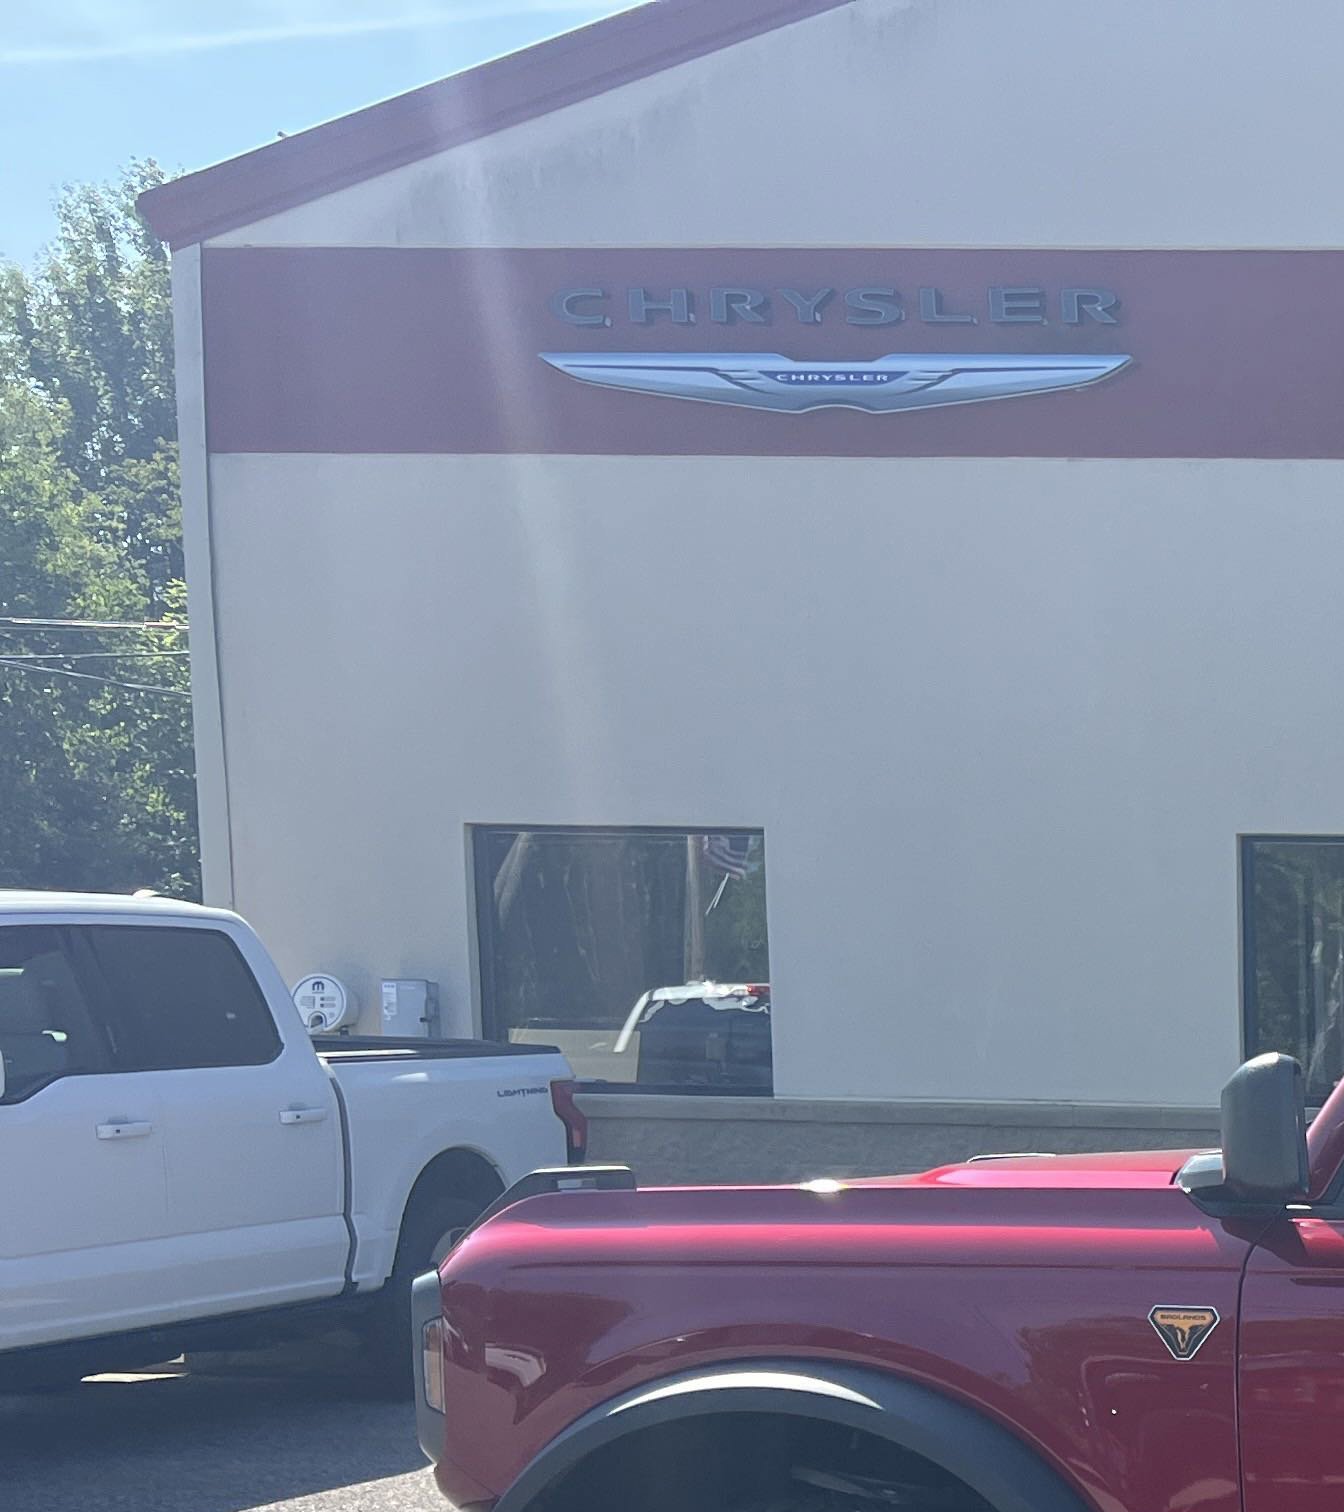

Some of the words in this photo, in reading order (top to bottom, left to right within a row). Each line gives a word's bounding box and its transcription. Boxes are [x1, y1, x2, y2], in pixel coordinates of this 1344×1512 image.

[551, 287, 1119, 325] CHRYSLER
[776, 374, 889, 382] CHRYSLER
[1160, 1313, 1207, 1321] BADLANDS
